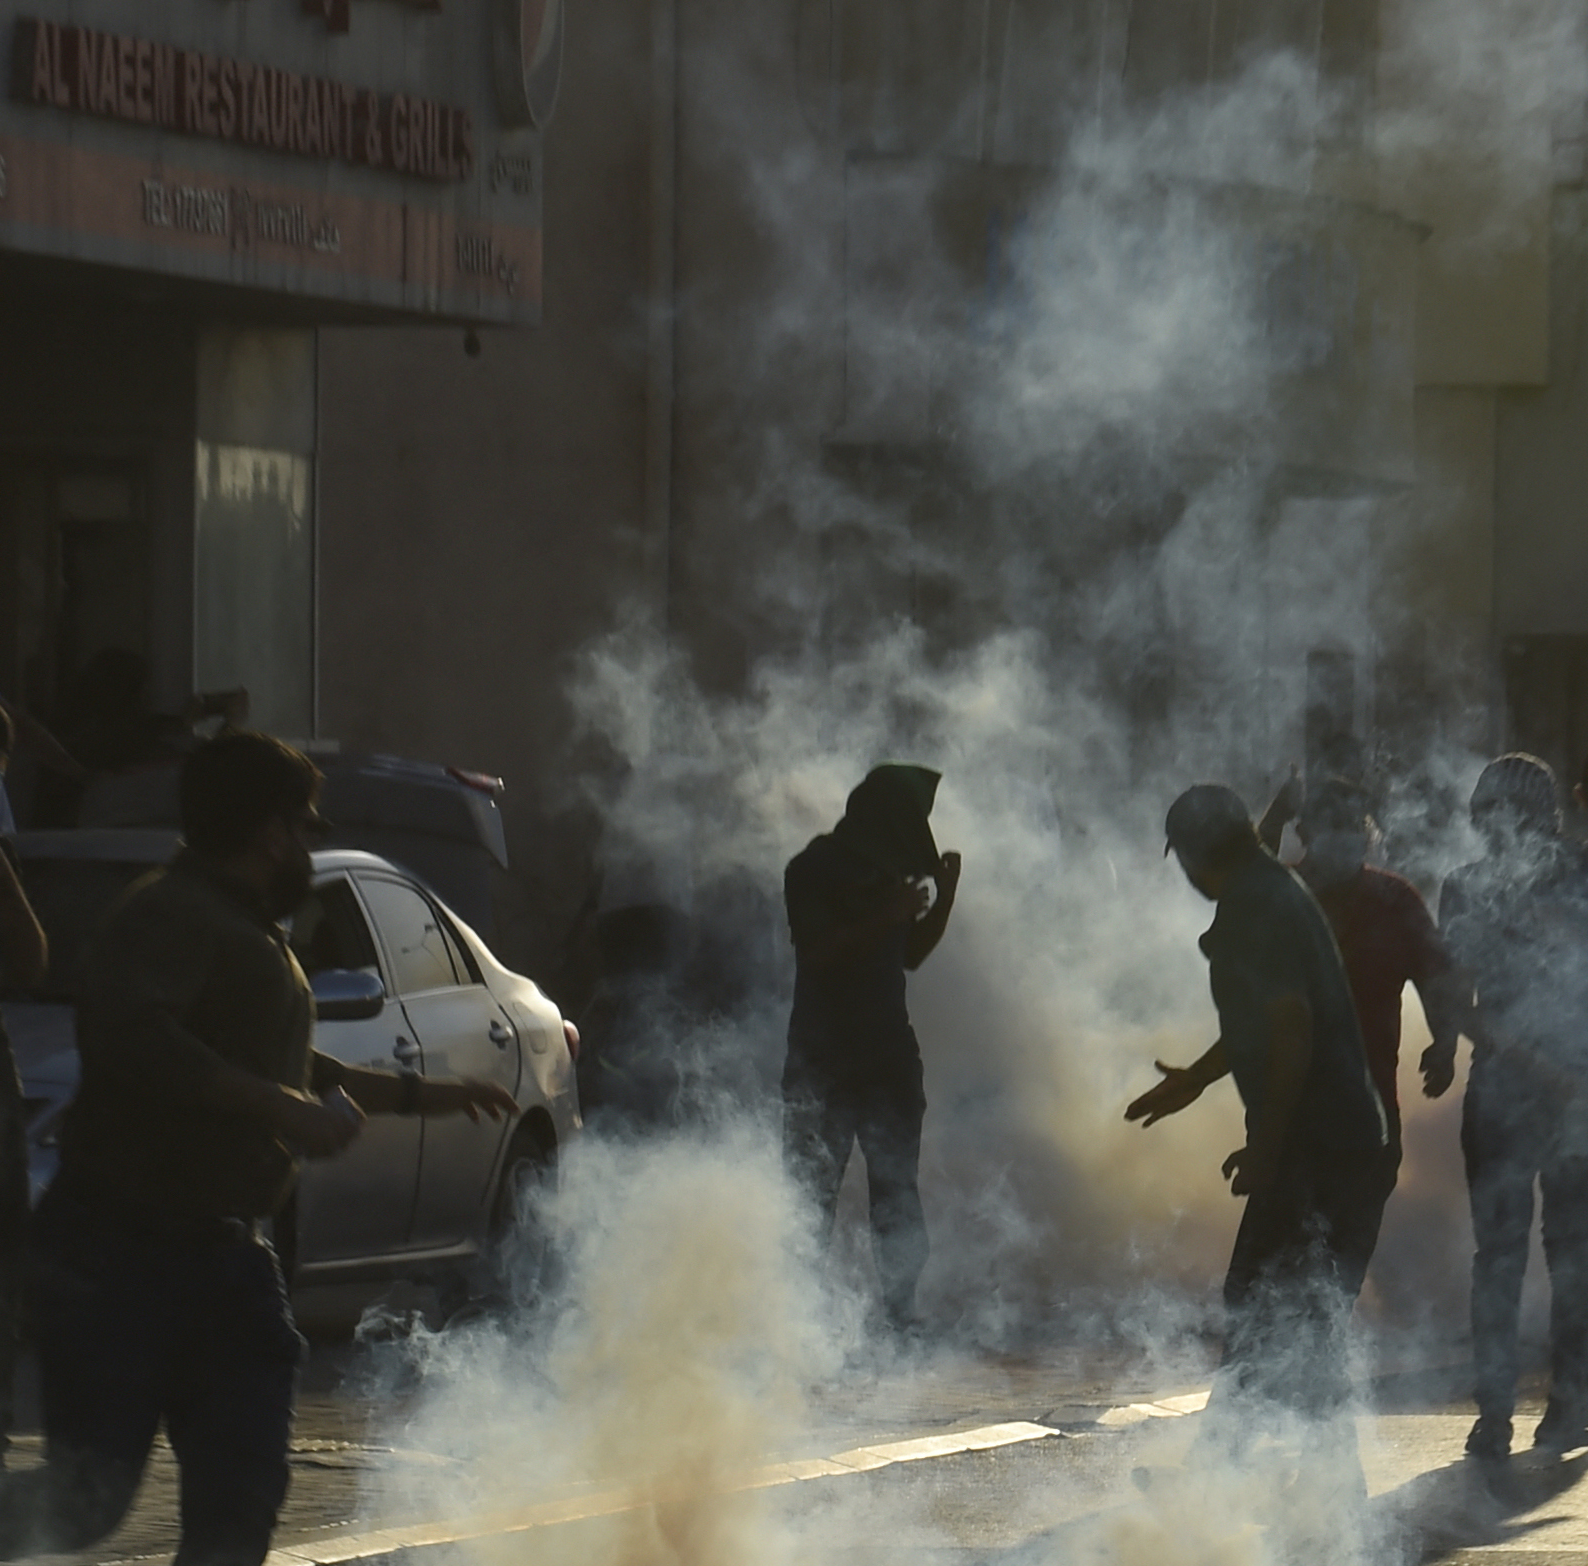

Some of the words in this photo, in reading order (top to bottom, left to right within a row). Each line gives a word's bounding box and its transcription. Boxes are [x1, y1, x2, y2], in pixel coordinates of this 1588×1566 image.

[32, 18, 70, 107] AL
[77, 26, 176, 126] NAEEM
[184, 50, 356, 160] RESTAURANT
[364, 85, 384, 169] &
[391, 92, 474, 184] GRILLS
